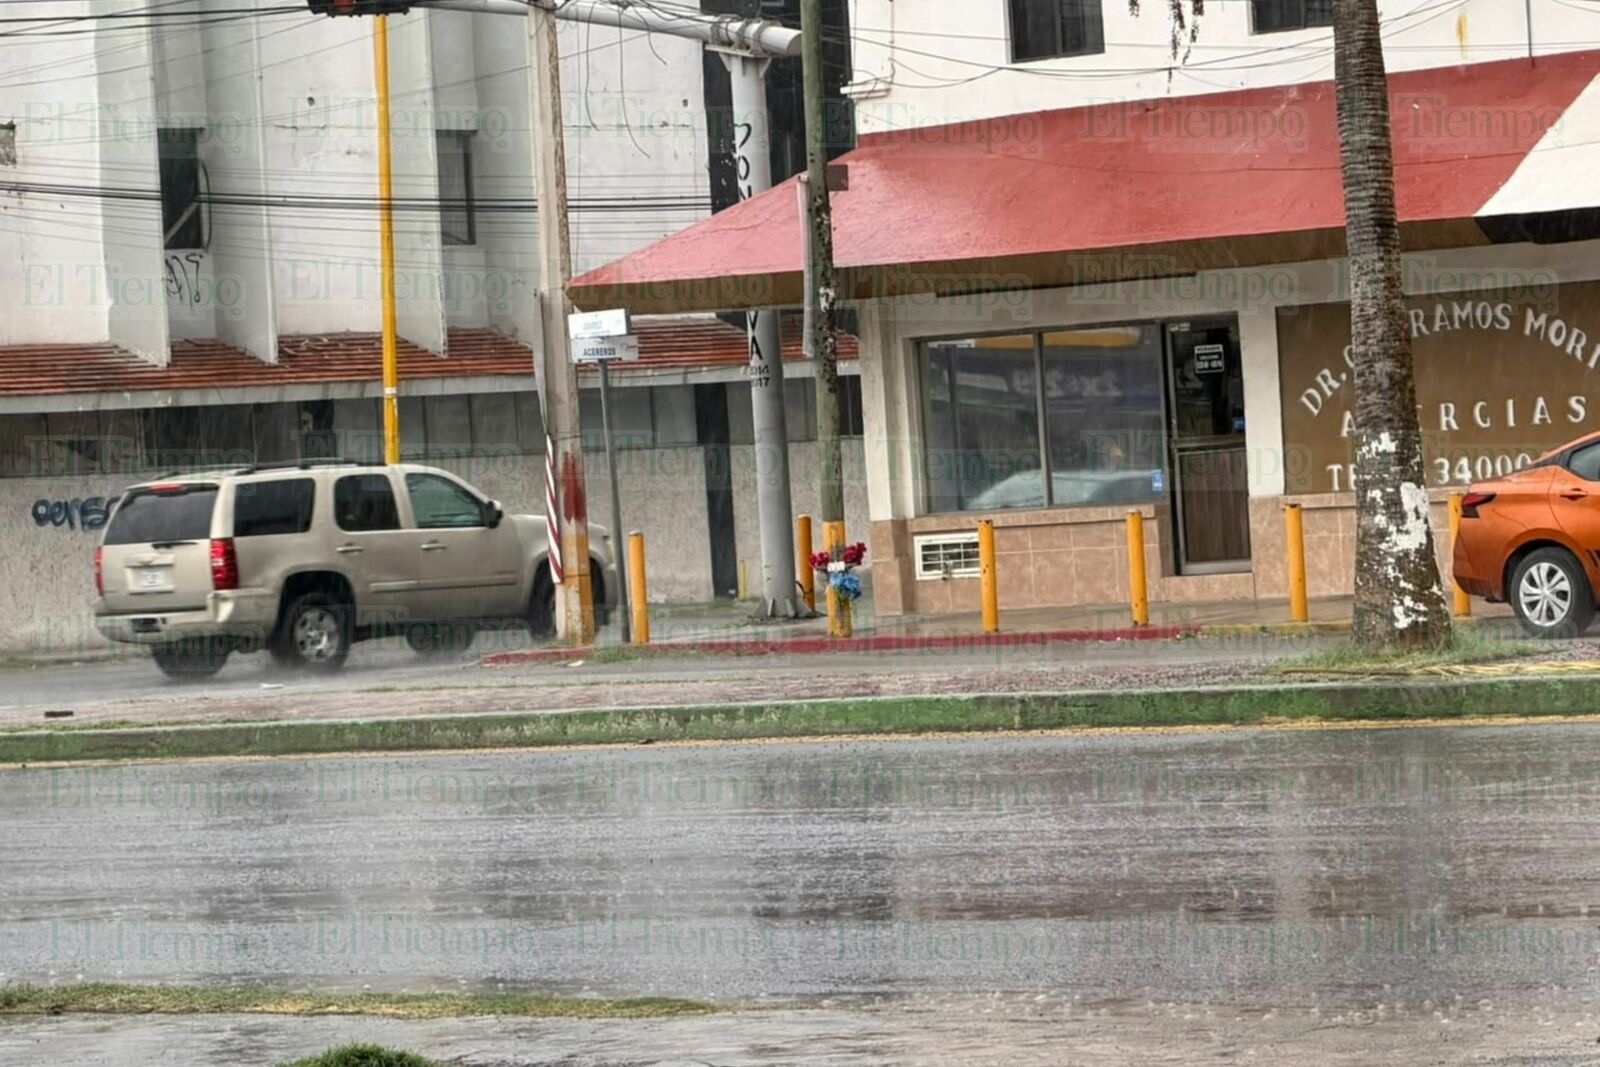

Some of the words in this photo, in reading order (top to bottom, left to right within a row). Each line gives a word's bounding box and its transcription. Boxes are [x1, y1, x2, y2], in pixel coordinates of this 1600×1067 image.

[1300, 367, 1347, 417] DR.
[1408, 301, 1513, 339] RAMOS
[1341, 395, 1587, 438] ARGIAS
